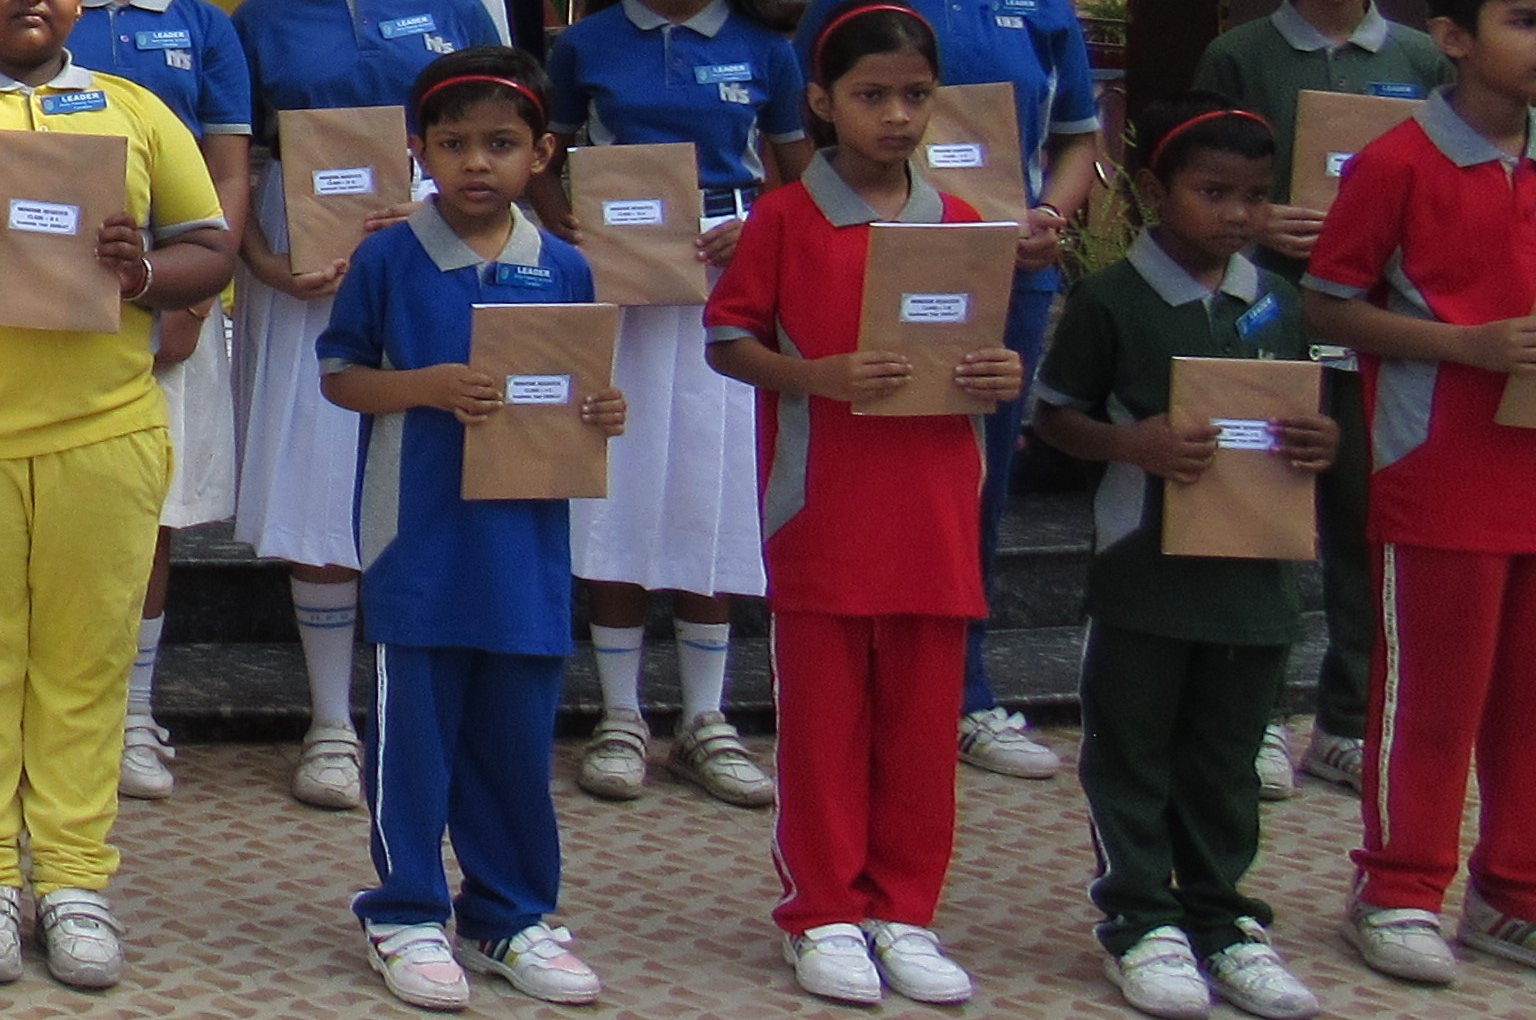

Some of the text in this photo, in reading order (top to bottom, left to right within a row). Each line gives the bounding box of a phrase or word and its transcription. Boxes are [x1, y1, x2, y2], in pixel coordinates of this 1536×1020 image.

[1005, 0, 1035, 7] LEADER
[397, 17, 428, 27] LEADER
[712, 65, 746, 73] LEADER
[61, 93, 99, 103] LEADER
[517, 266, 551, 277] LEADER
